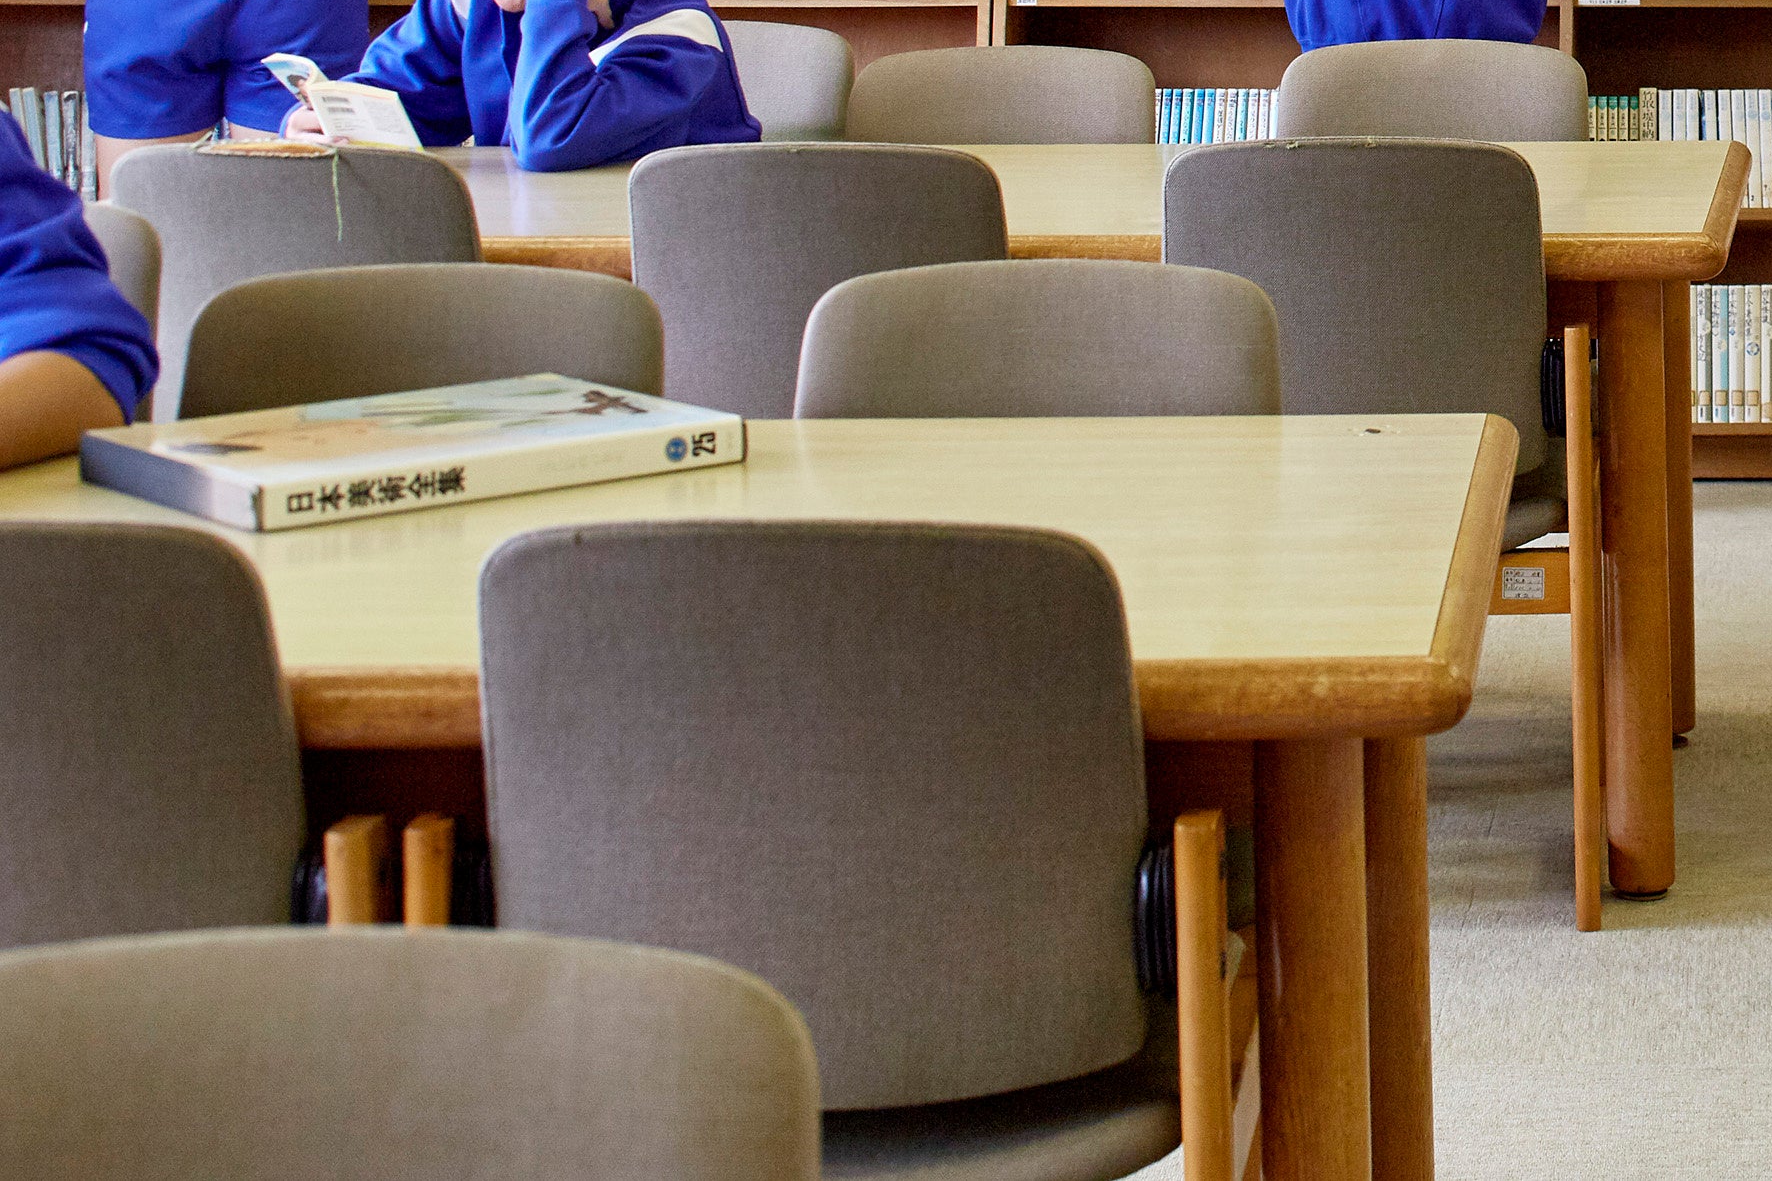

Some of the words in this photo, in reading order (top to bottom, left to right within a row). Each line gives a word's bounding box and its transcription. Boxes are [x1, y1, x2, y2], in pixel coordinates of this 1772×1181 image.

[287, 465, 466, 515] 日本美術全集
[691, 431, 717, 457] 25
